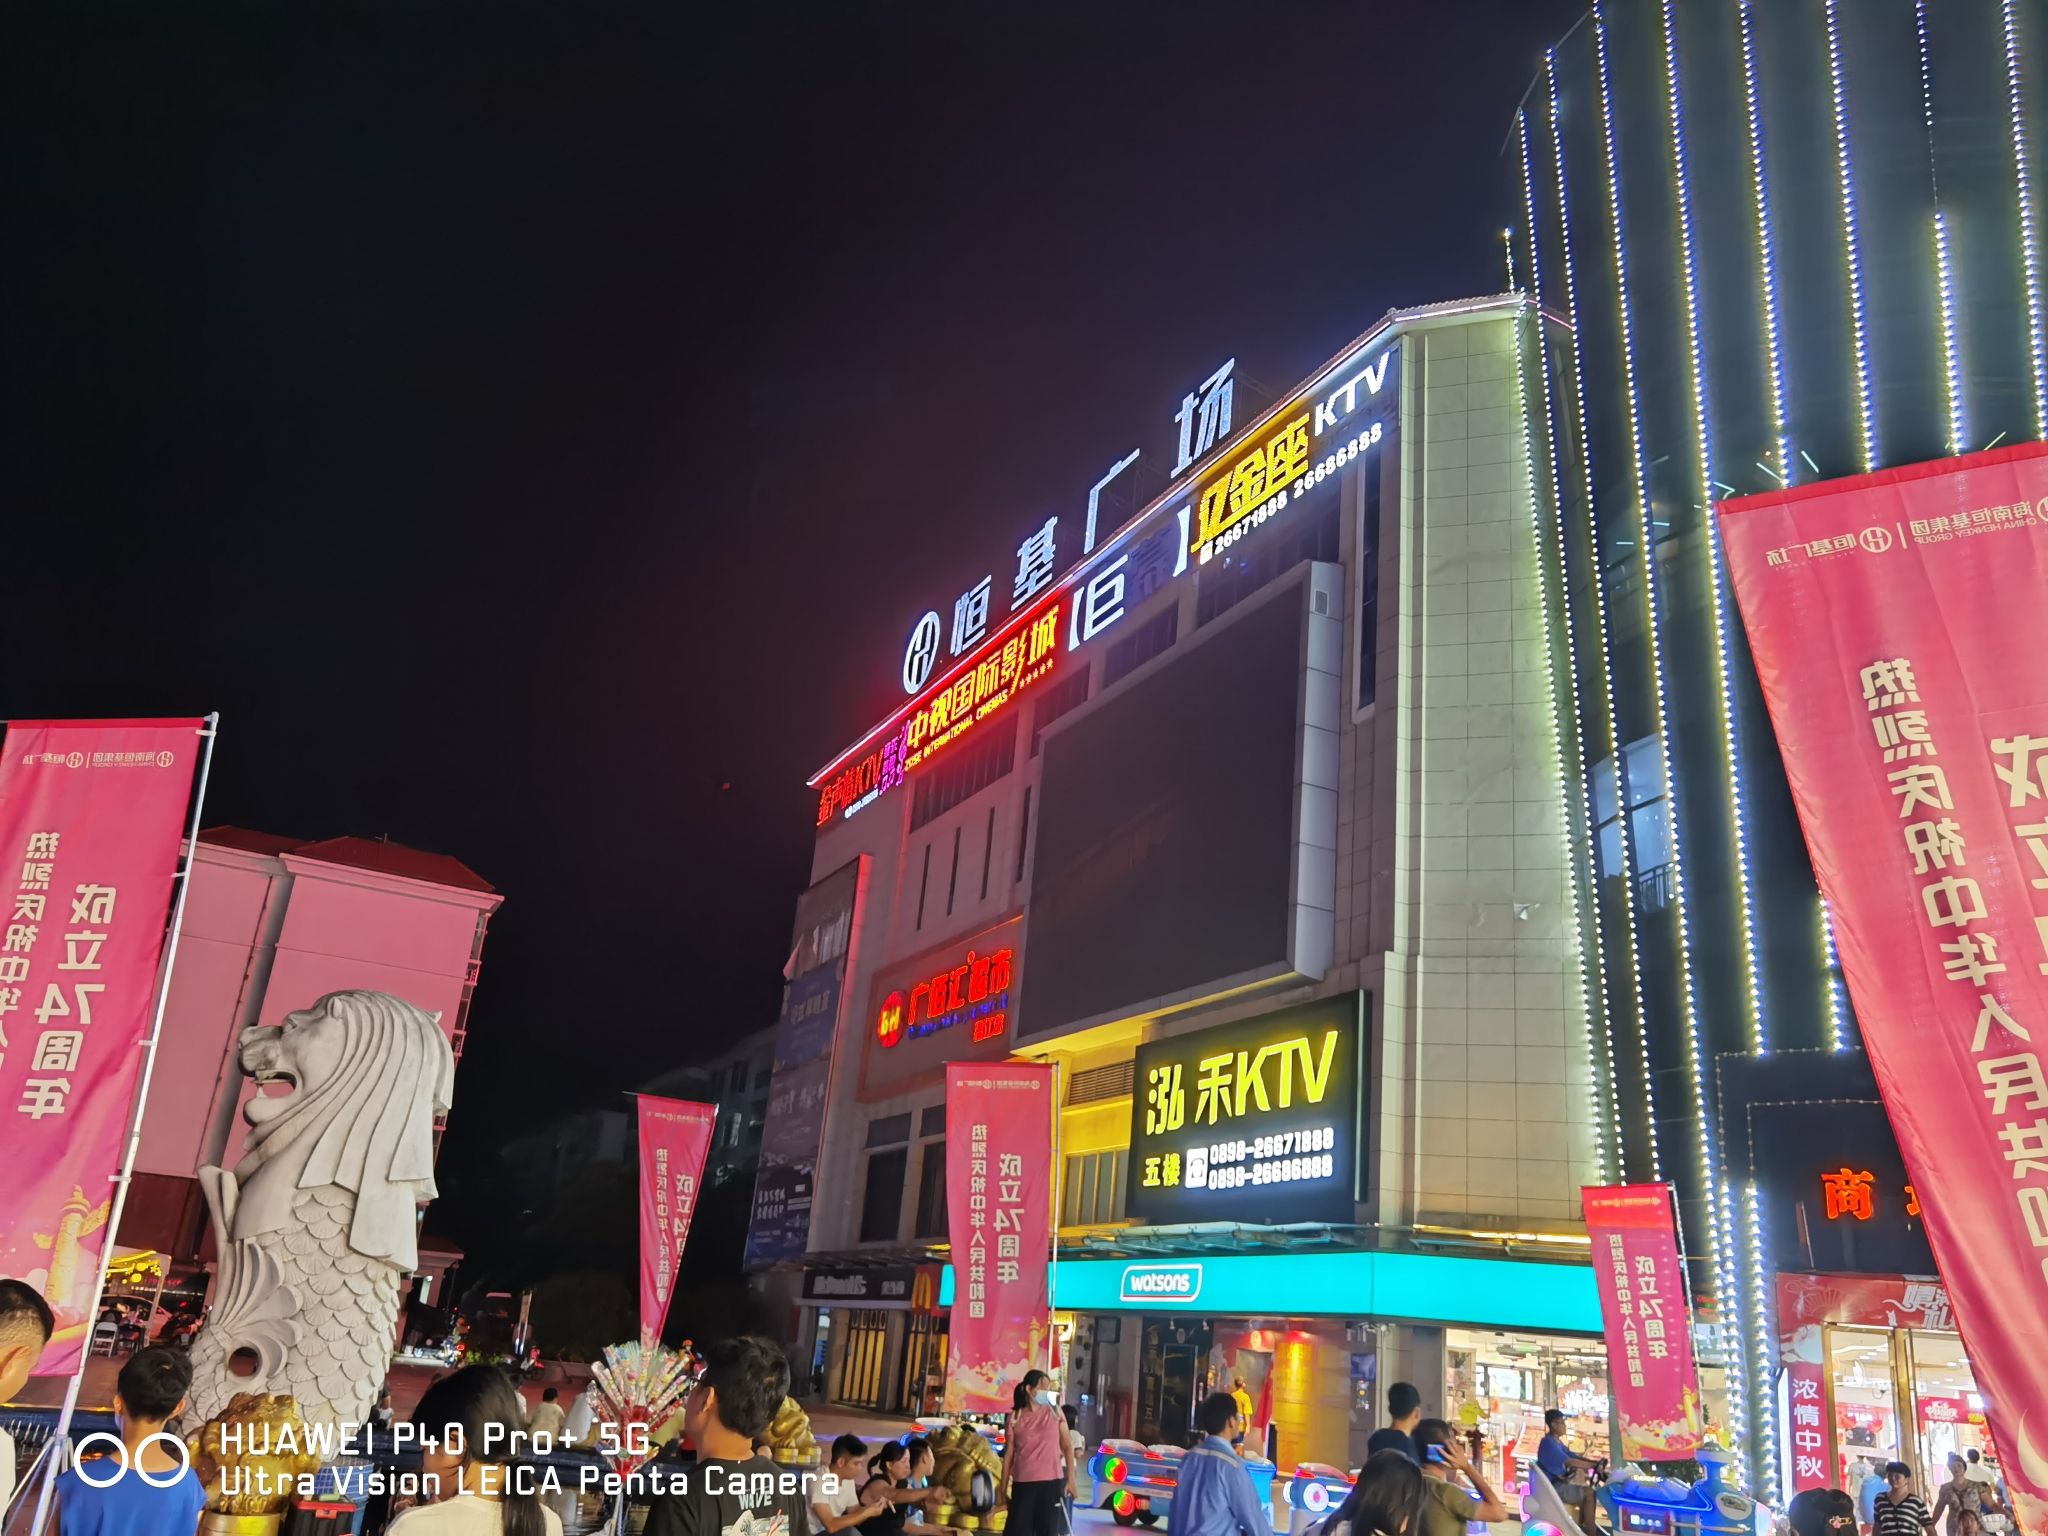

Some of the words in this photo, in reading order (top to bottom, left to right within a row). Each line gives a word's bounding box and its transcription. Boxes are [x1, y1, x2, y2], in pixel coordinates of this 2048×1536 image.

[950, 357, 1235, 656] 恒基广场
[1214, 490, 1288, 555] 26671888
[1293, 422, 1383, 499] 26686888
[907, 605, 1060, 748] 中视国际影城
[1142, 1153, 1182, 1188] 五楼
[1208, 1154, 1333, 1190] 0898-26686888
[1210, 1127, 1334, 1165] 0898-26671888
[1131, 1273, 1190, 1292] watsons
[1791, 1378, 1825, 1480] 浓情中秋
